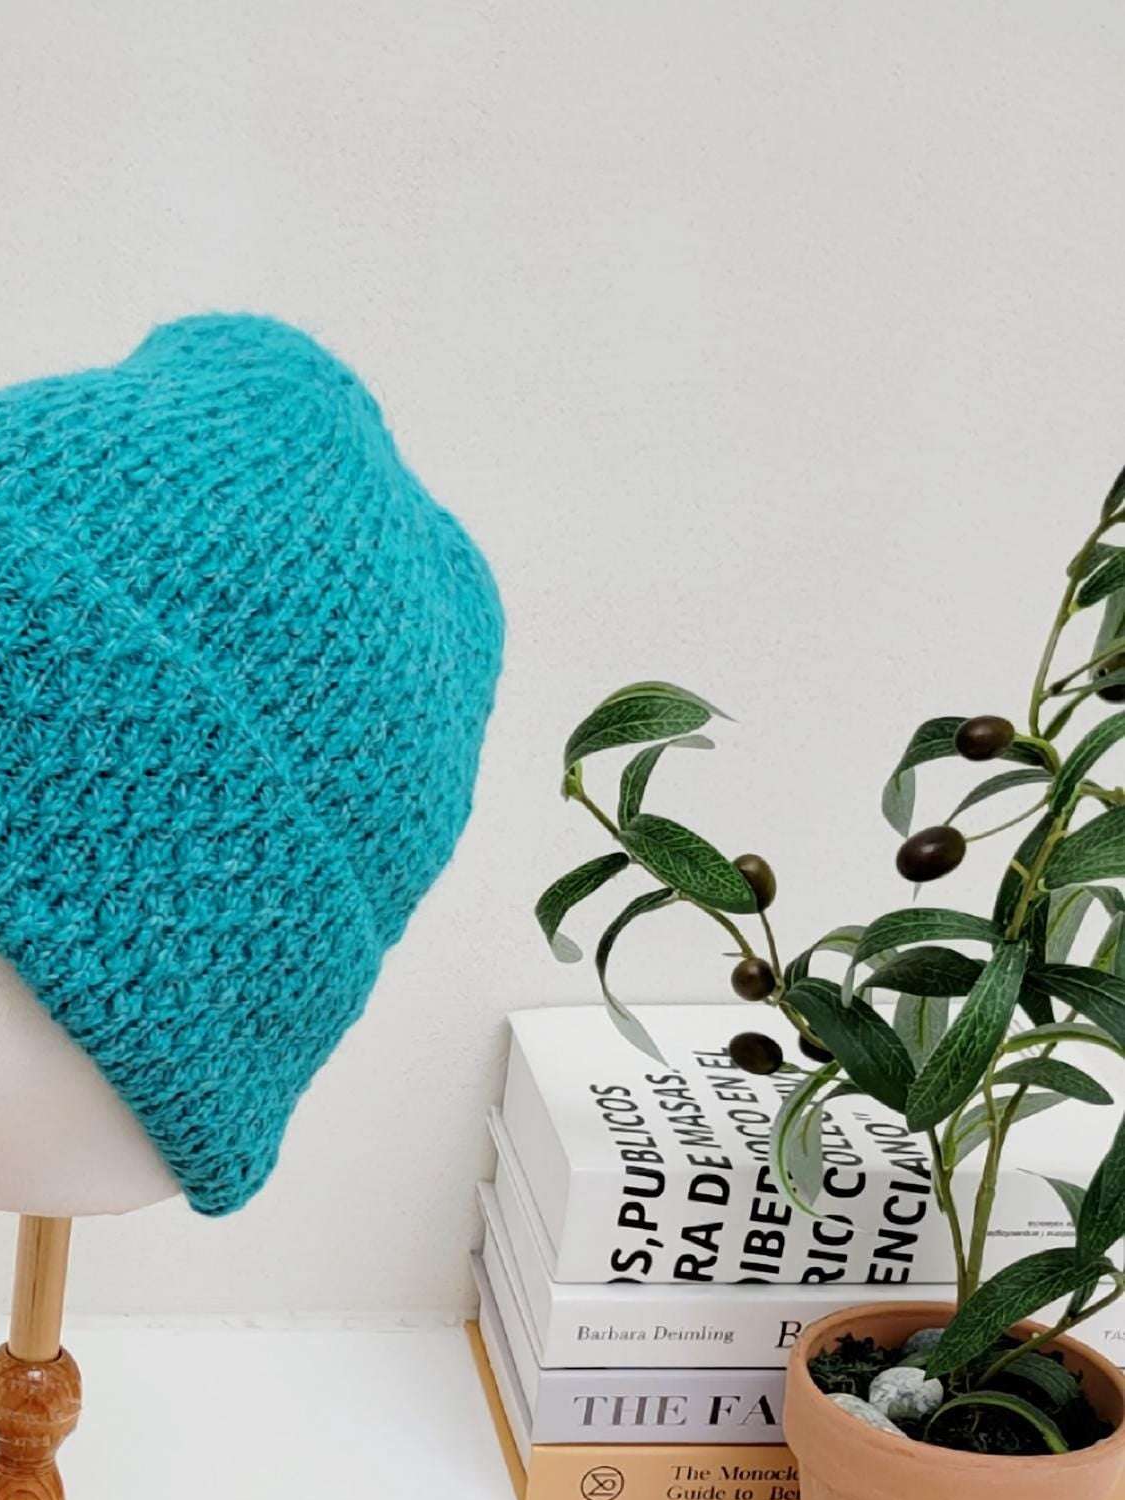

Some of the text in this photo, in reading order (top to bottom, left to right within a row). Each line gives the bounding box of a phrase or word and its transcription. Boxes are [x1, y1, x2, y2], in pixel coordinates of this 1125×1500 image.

[692, 1047, 739, 1069] EL
[707, 1075, 758, 1103] EN
[686, 1154, 733, 1206] DE
[673, 1222, 723, 1282] RA
[577, 1326, 646, 1341] Barbara
[653, 1325, 735, 1343] Deimling
[573, 1396, 688, 1426] THE
[671, 1466, 711, 1481] The
[666, 1485, 726, 1500] Guide
[734, 1487, 753, 1500] to
